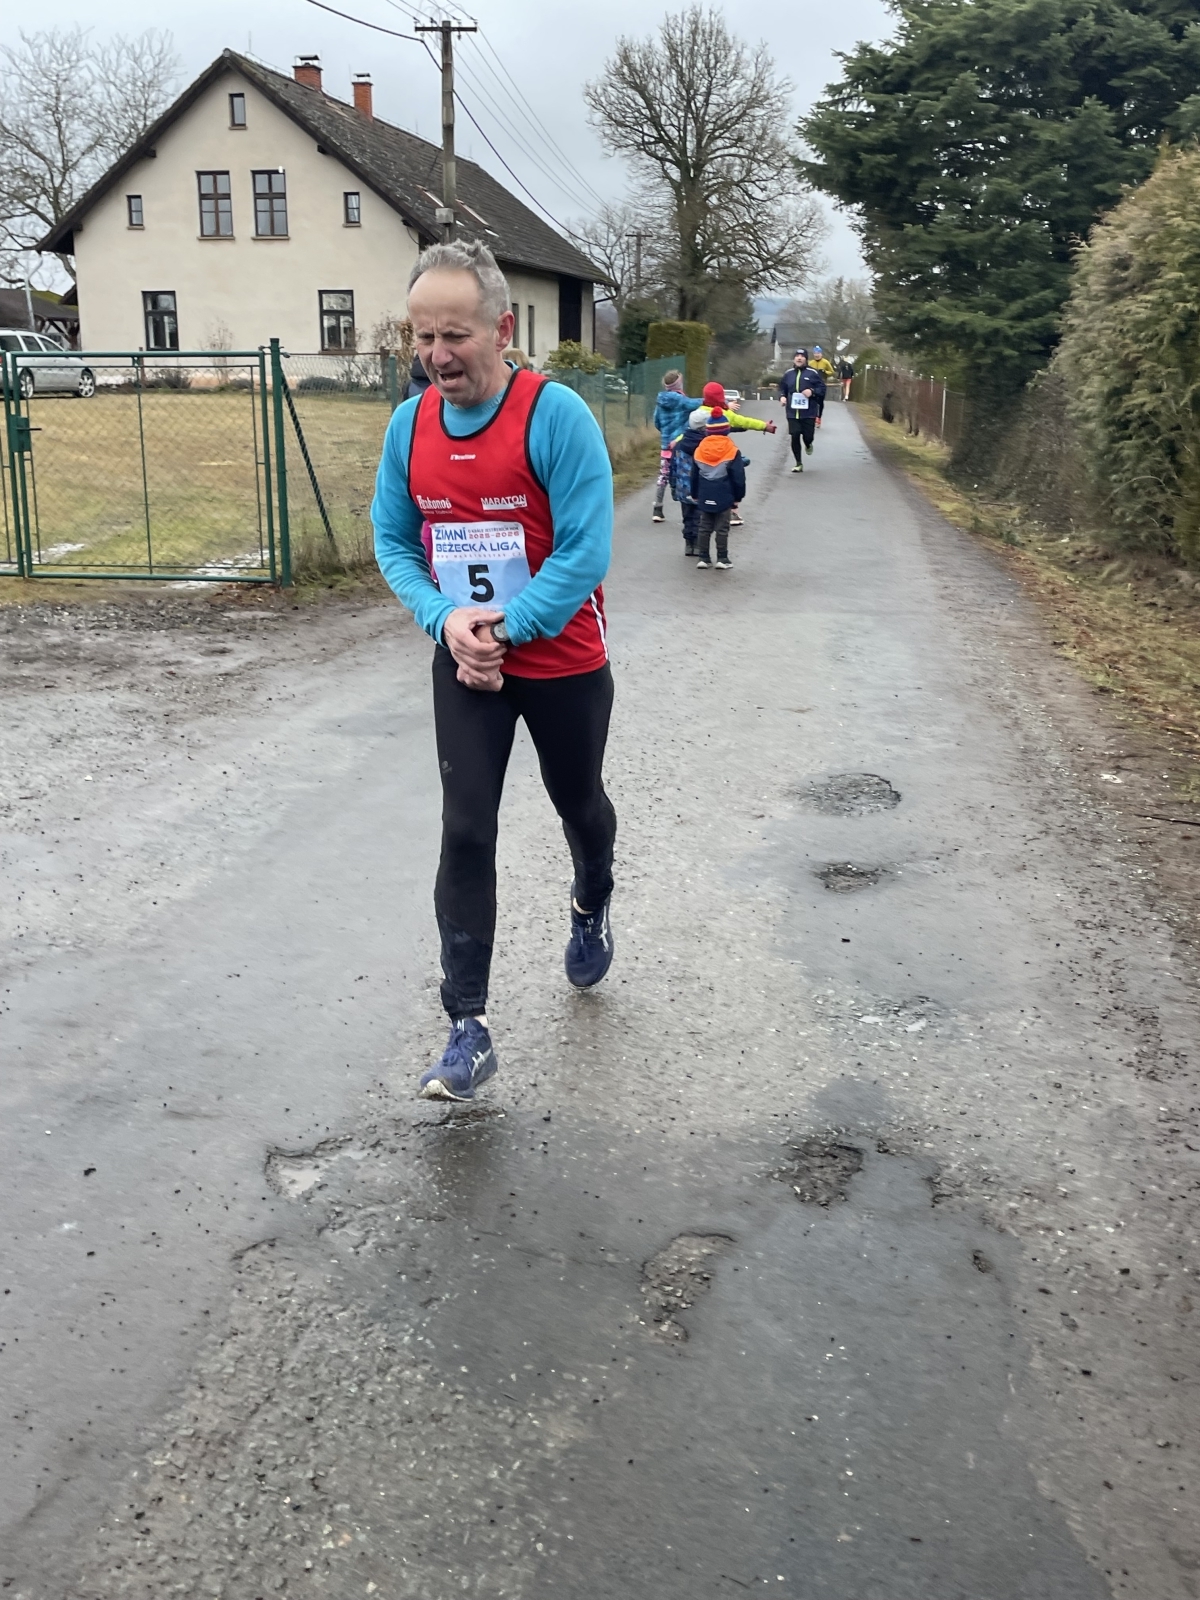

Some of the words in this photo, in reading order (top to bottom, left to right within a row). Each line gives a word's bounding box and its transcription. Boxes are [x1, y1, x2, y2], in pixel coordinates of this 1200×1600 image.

[480, 494, 526, 505] MARATON
[434, 527, 467, 541] ZIMNÍ
[469, 531, 520, 539] 2025-2026
[435, 541, 487, 553] BĚŽECKÁ
[490, 541, 520, 552] LIGA
[467, 564, 495, 603] 5
